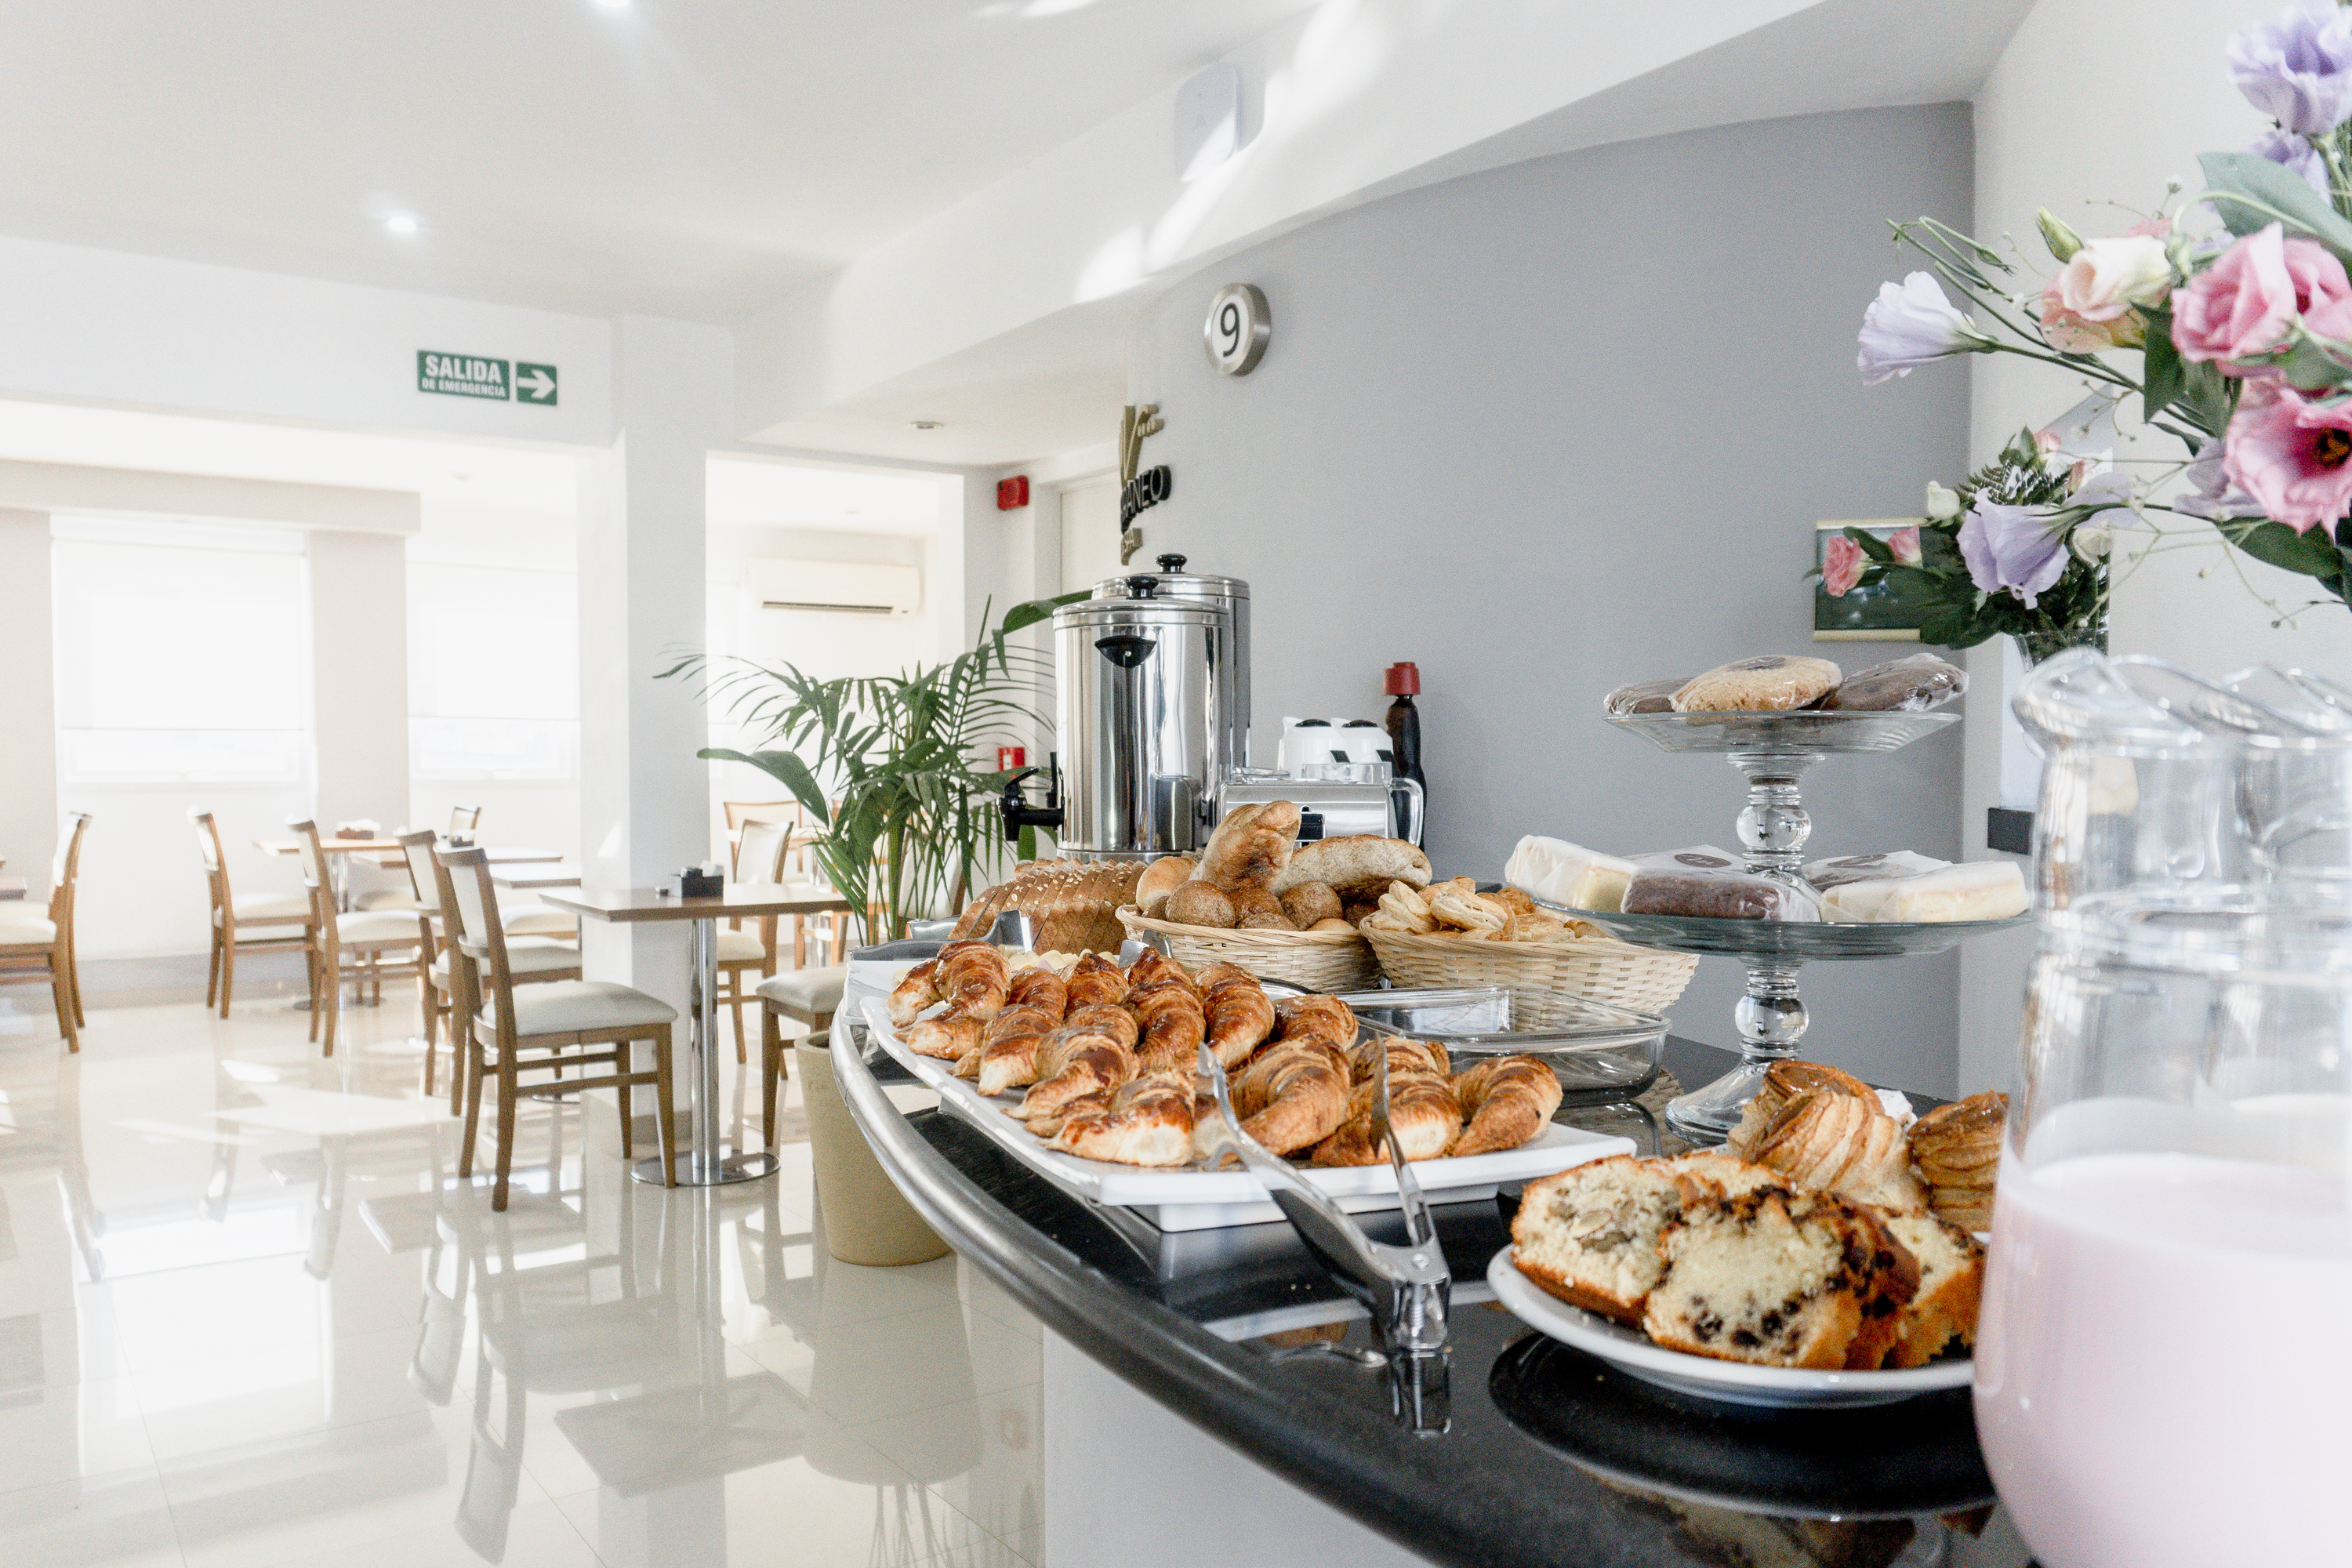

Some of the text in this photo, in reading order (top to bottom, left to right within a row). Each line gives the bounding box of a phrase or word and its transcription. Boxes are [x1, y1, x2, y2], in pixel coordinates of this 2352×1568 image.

[1221, 303, 1240, 358] 9
[425, 354, 502, 384] SALIDA
[422, 377, 506, 397] DE EMERGENCIA
